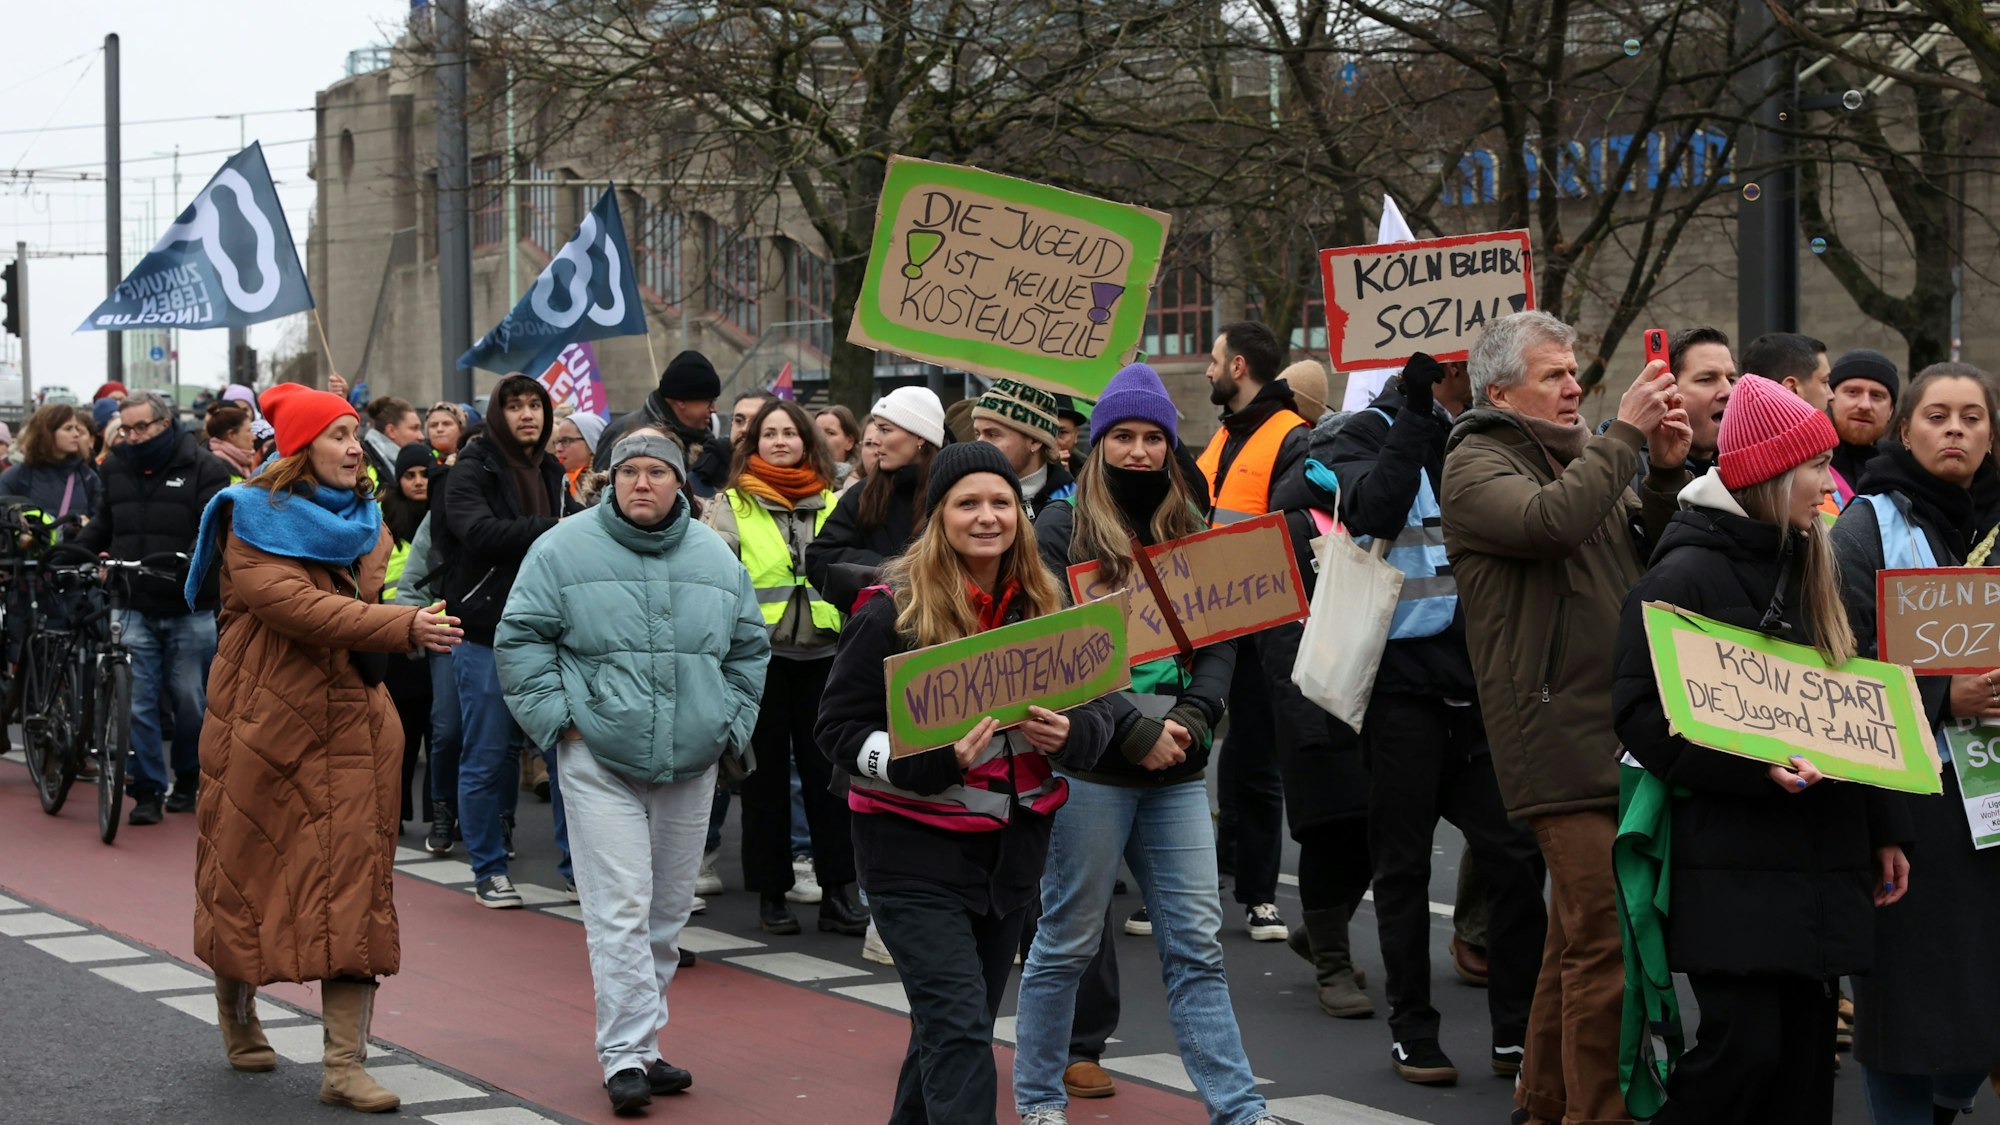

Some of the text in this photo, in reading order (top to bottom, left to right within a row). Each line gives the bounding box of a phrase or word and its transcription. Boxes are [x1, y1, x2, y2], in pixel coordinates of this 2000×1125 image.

[913, 192, 1124, 278] DIE JUGEND
[944, 249, 1087, 309] IST KEINE
[1354, 252, 1442, 299] KÖLN
[900, 279, 1108, 358] KOSTENSTELLE
[1897, 581, 1974, 615] KÖLN
[906, 670, 959, 724] WIR
[961, 634, 1064, 718] KÄMPFEN
[1716, 642, 1886, 721] KÖLN SPART
[1687, 679, 1897, 760] DIE Jugend ZAHLT
